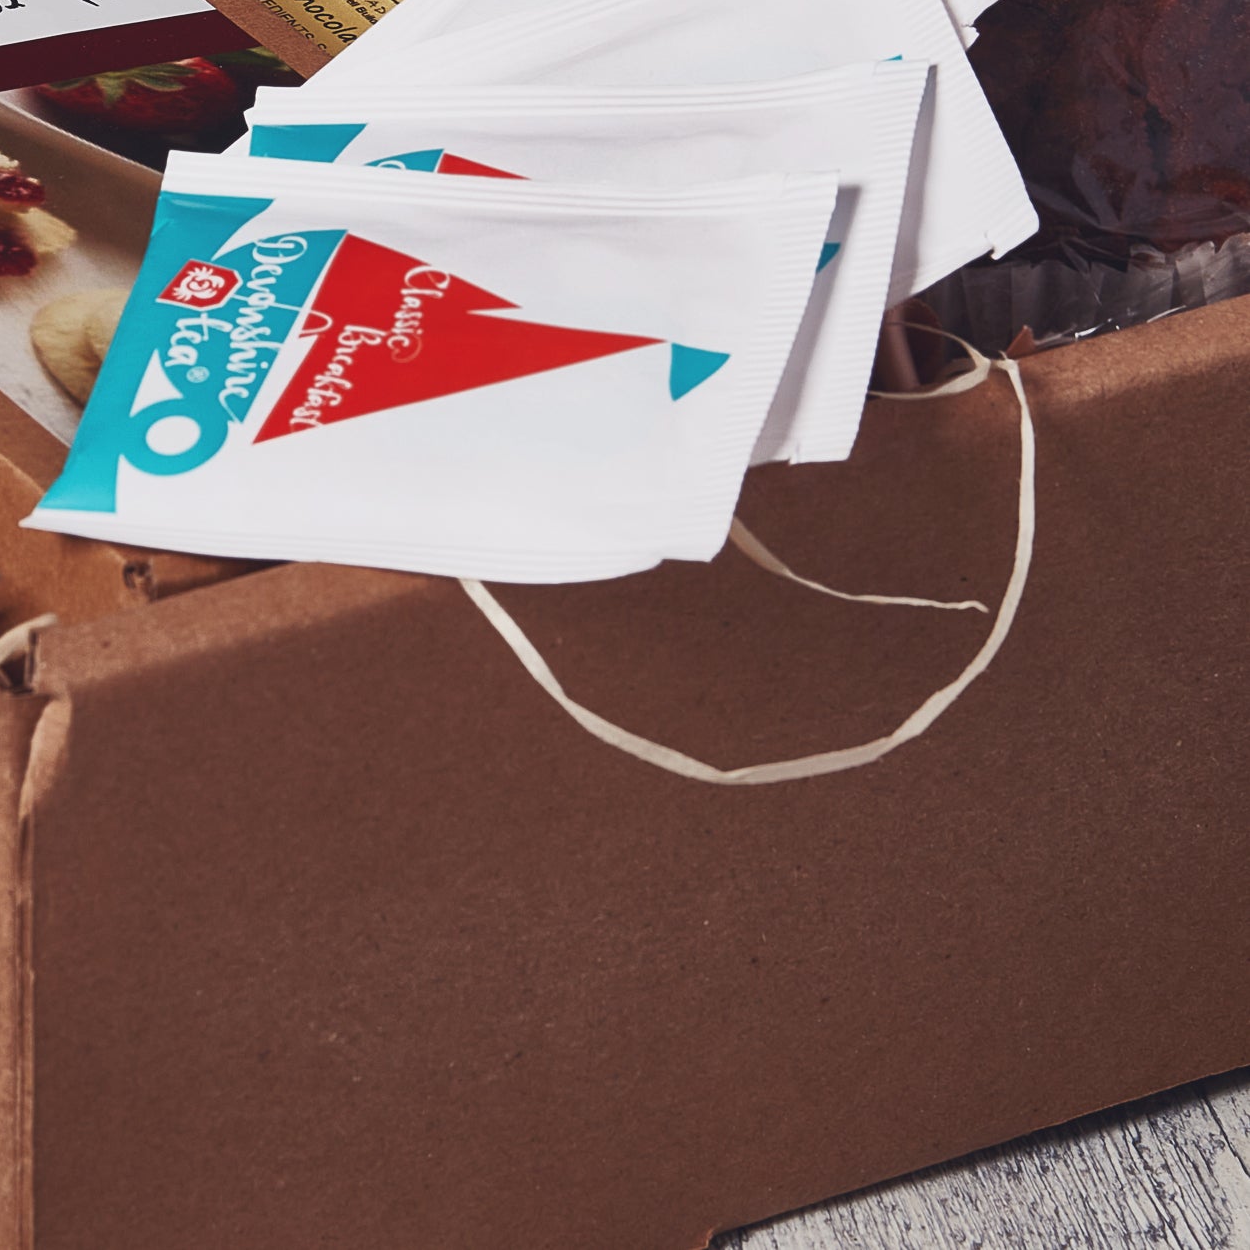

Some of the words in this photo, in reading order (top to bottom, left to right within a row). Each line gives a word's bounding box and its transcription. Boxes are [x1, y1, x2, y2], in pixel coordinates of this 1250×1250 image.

[164, 312, 233, 367] tea
[218, 235, 308, 424] Devonshire
[386, 264, 450, 355] Classic
[289, 324, 388, 429] Breakfast
